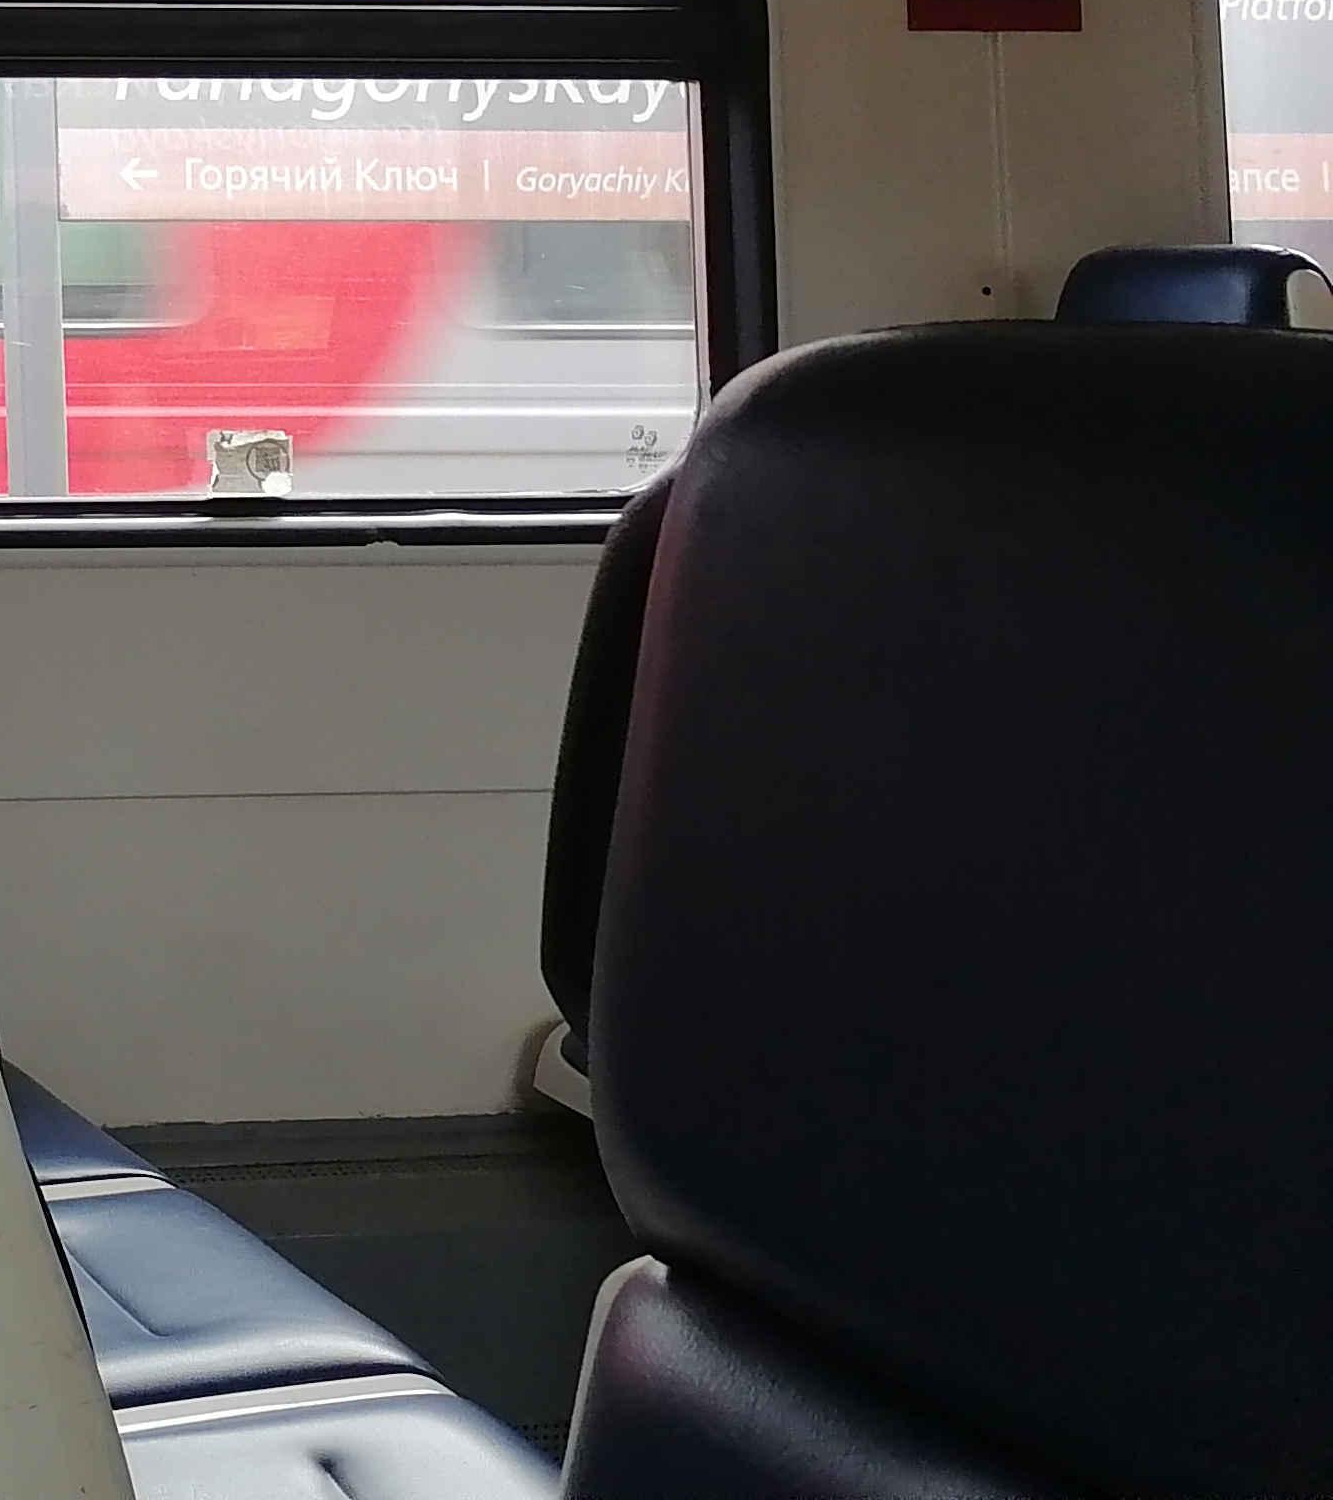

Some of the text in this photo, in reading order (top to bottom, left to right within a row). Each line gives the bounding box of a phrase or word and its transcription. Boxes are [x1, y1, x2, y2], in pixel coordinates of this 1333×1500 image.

[185, 155, 458, 198] Горячий Ключ
[516, 166, 657, 198] Goryachiy
